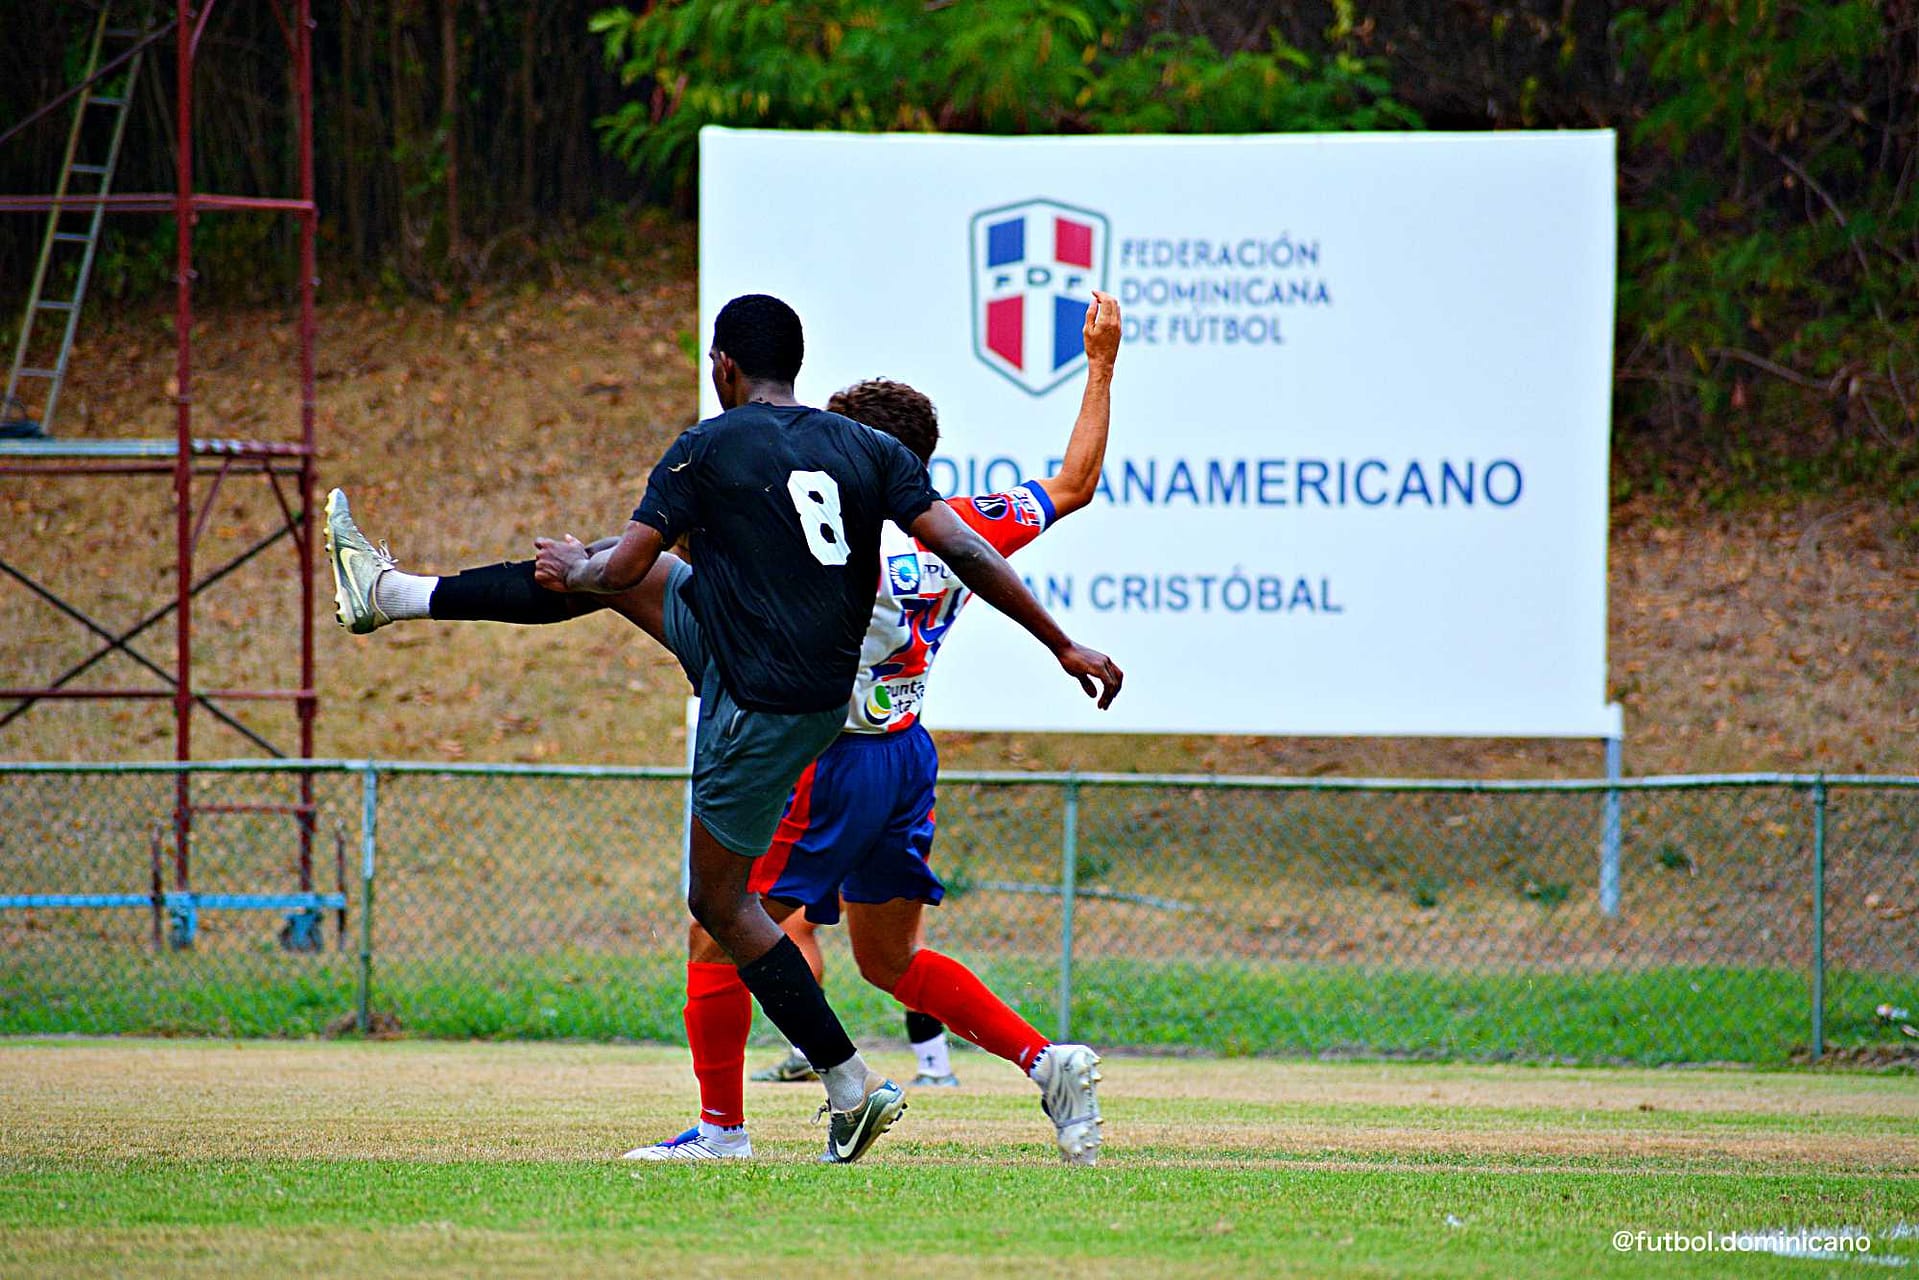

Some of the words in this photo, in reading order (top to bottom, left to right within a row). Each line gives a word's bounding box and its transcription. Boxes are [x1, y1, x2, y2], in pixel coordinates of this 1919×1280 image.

[1121, 232, 1320, 269] FEDERACIÓN
[1120, 276, 1332, 306] DOMINICANA
[1121, 315, 1161, 344] DE
[1168, 306, 1284, 345] FÚTBOL
[786, 470, 852, 566] 8
[1090, 564, 1344, 613] CRISTÓBAL
